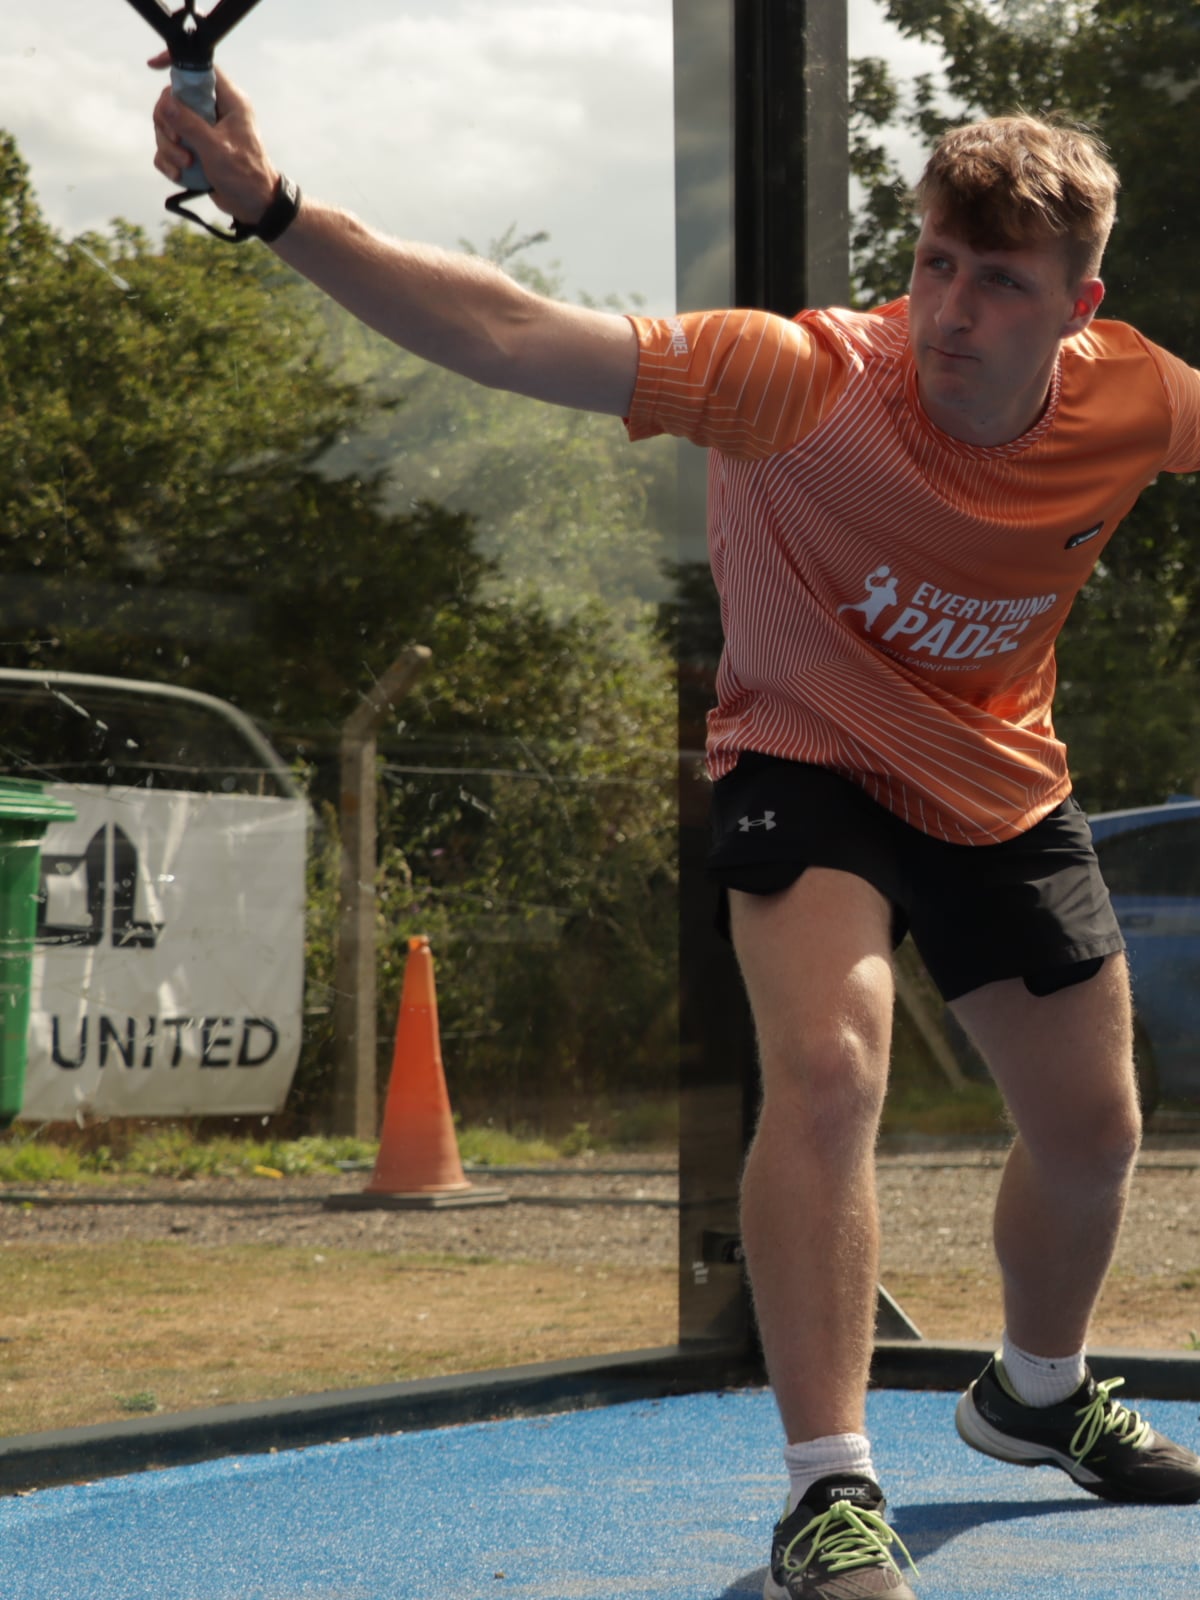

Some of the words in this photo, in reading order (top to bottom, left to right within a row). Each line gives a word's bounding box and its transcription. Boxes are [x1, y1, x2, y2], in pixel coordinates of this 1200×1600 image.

[911, 581, 1057, 622] EVERYTHING
[881, 607, 1031, 659] PADEL
[52, 1015, 279, 1069] UNITED
